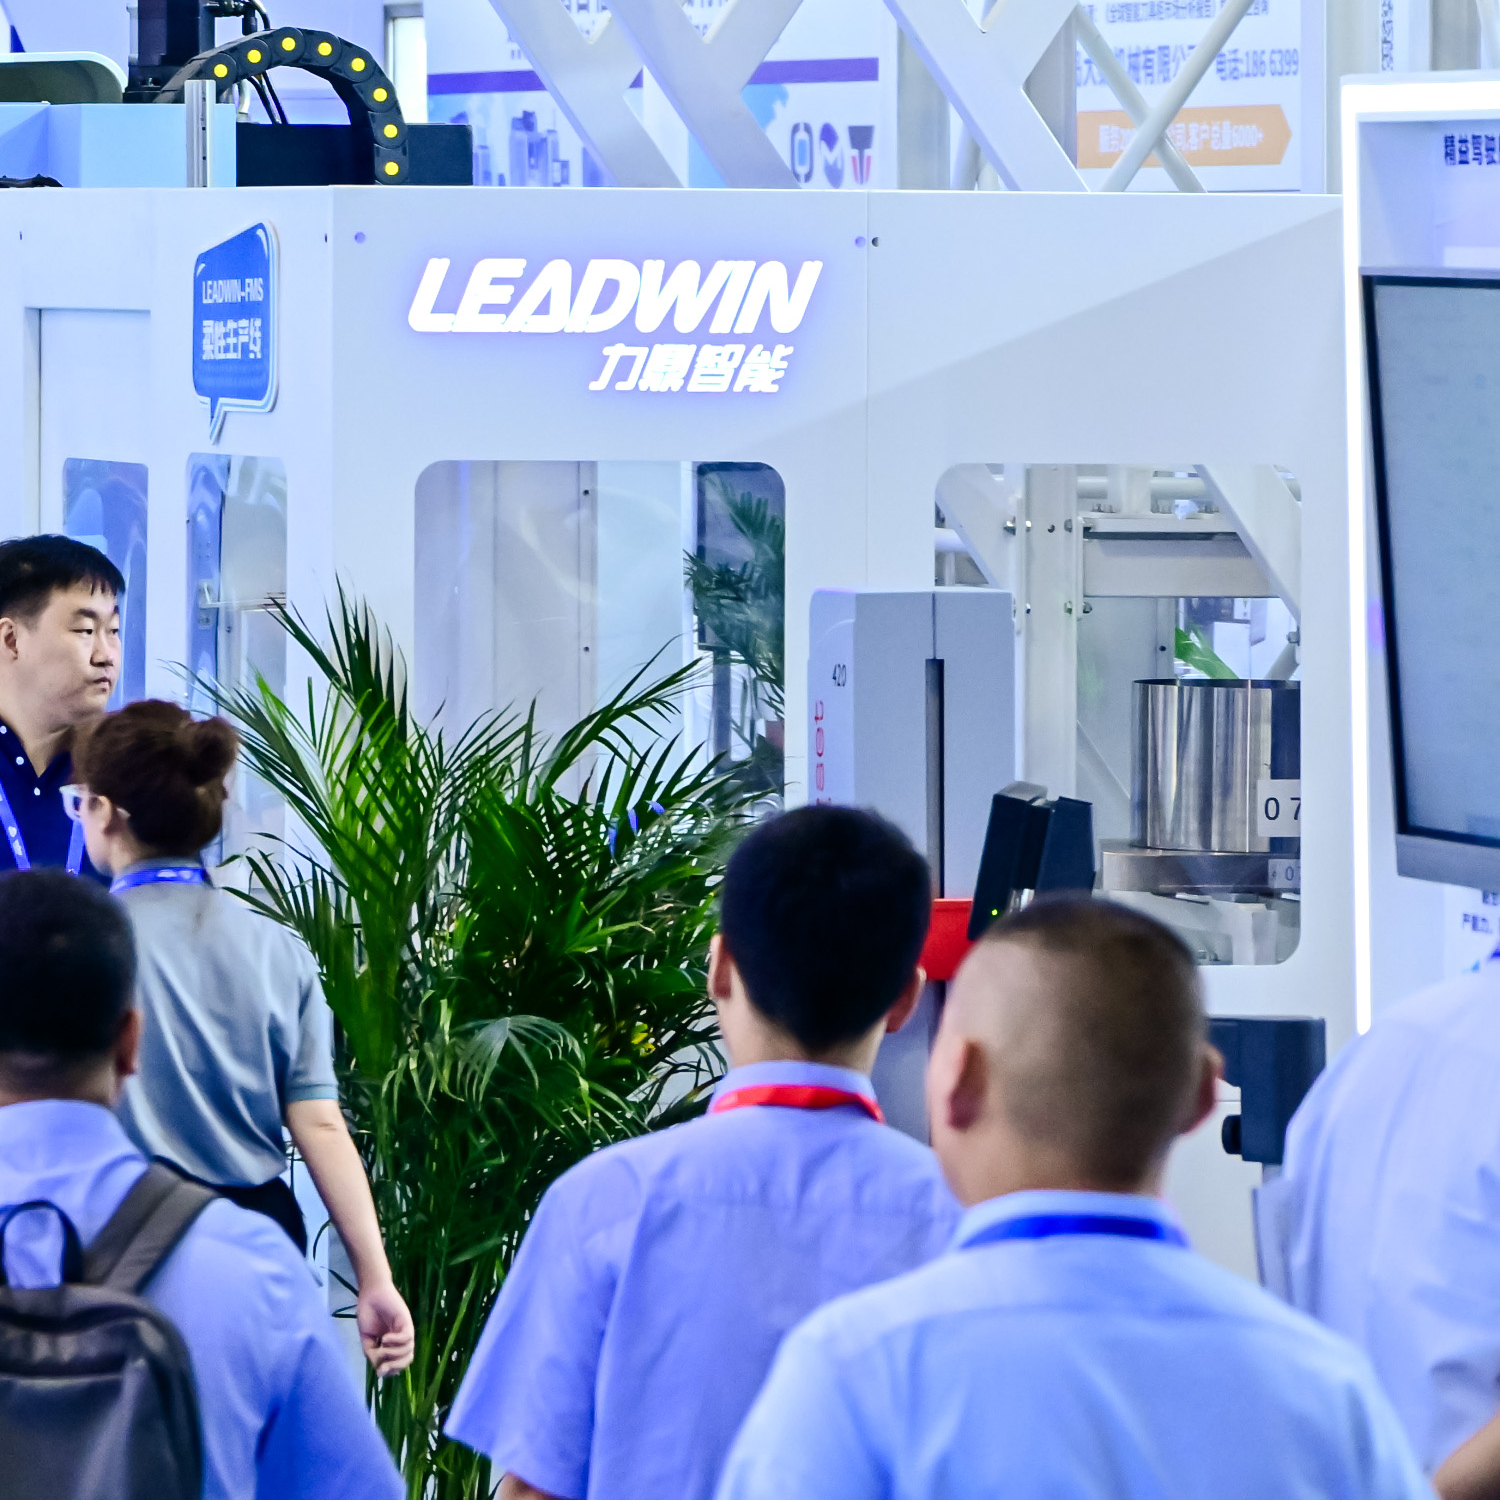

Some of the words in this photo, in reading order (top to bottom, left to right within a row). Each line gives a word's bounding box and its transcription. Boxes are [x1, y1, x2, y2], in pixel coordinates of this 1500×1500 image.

[202, 277, 264, 304] LEADWIN-FMS
[407, 256, 825, 337] LEADWIN
[202, 317, 262, 360] 柔性生产线
[588, 344, 795, 394] 力鼎智能
